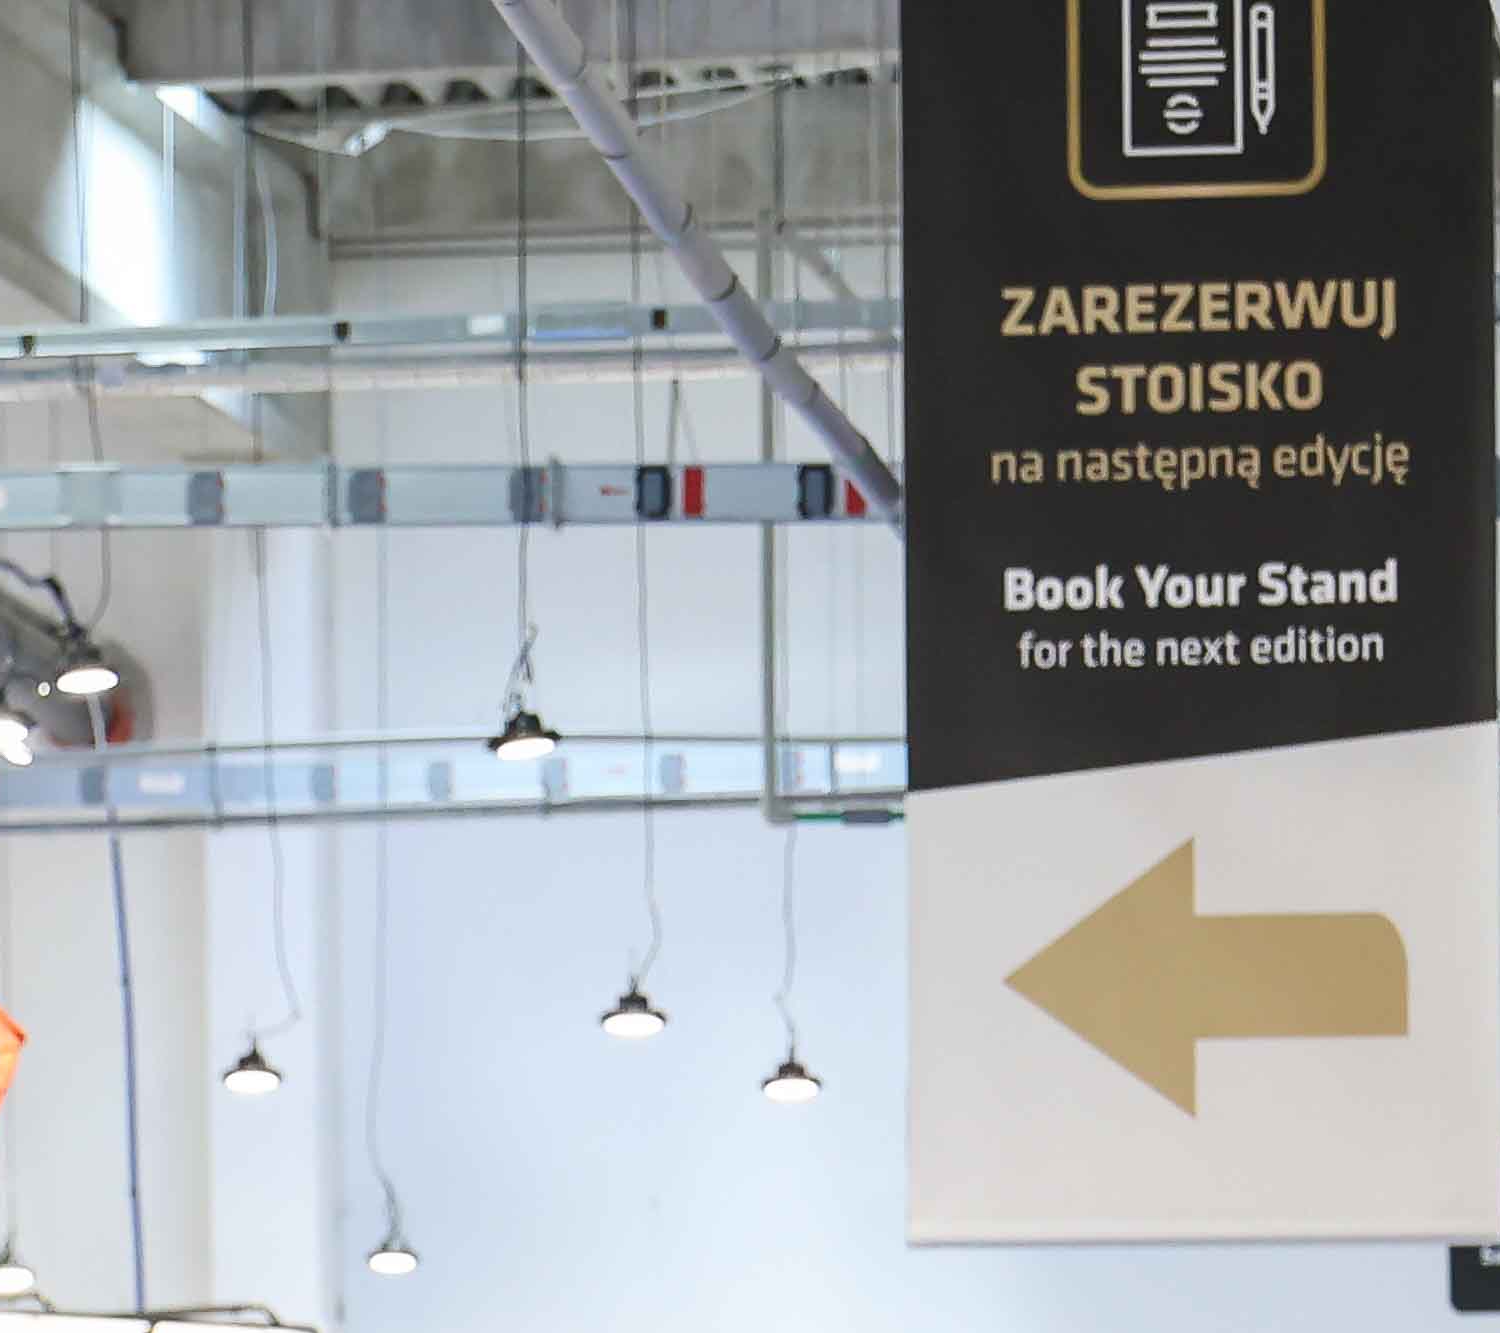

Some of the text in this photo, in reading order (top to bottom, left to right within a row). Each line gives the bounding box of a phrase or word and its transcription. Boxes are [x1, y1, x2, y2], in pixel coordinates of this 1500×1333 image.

[999, 278, 1397, 340] ZAREZERWUJ
[1075, 361, 1323, 415] STOISKO
[990, 433, 1410, 490] na następną edycję
[1003, 558, 1398, 613] Book Your Stand
[1018, 626, 1384, 670] for the next edition
